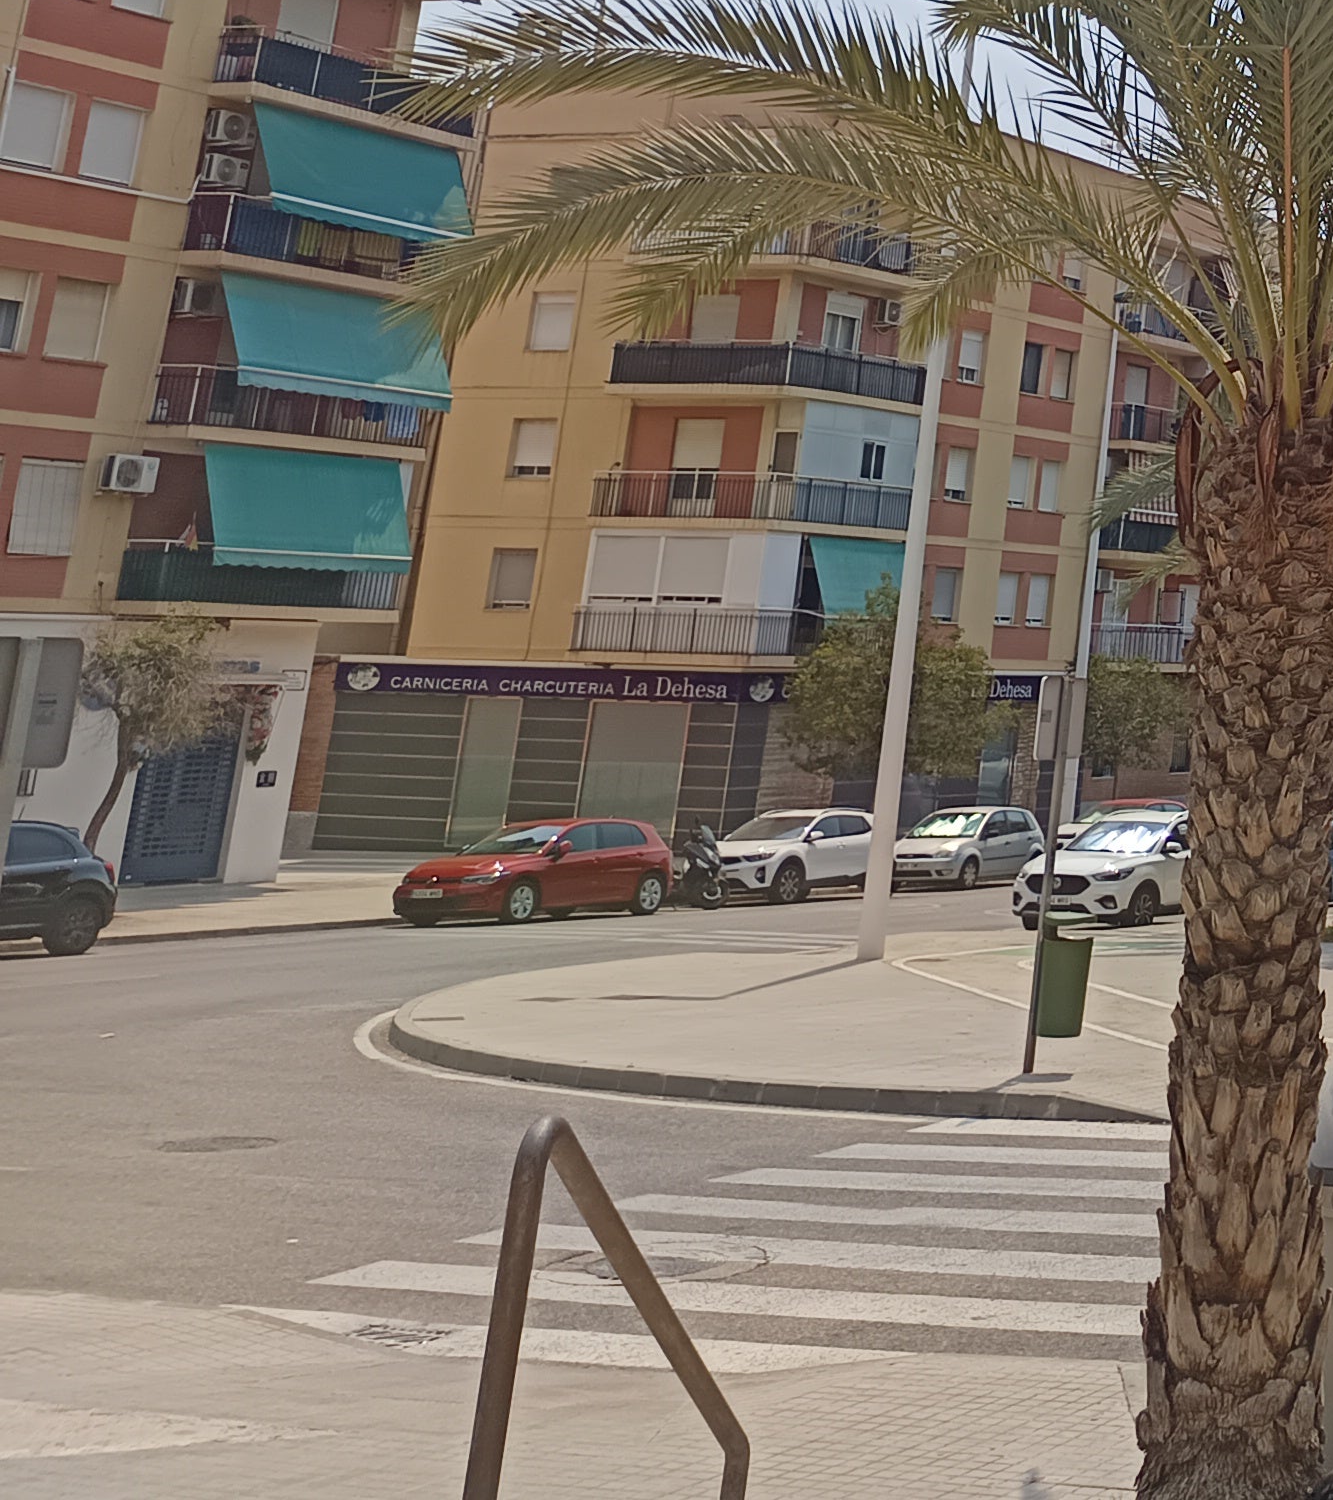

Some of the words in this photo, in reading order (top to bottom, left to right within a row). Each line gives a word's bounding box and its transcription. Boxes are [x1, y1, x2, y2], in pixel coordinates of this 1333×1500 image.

[390, 676, 489, 691] CARNICERIA
[499, 679, 615, 695] CHARCUTERIA
[622, 675, 648, 697] La
[653, 676, 729, 698] Dehesa
[989, 678, 1033, 698] Dehesa
